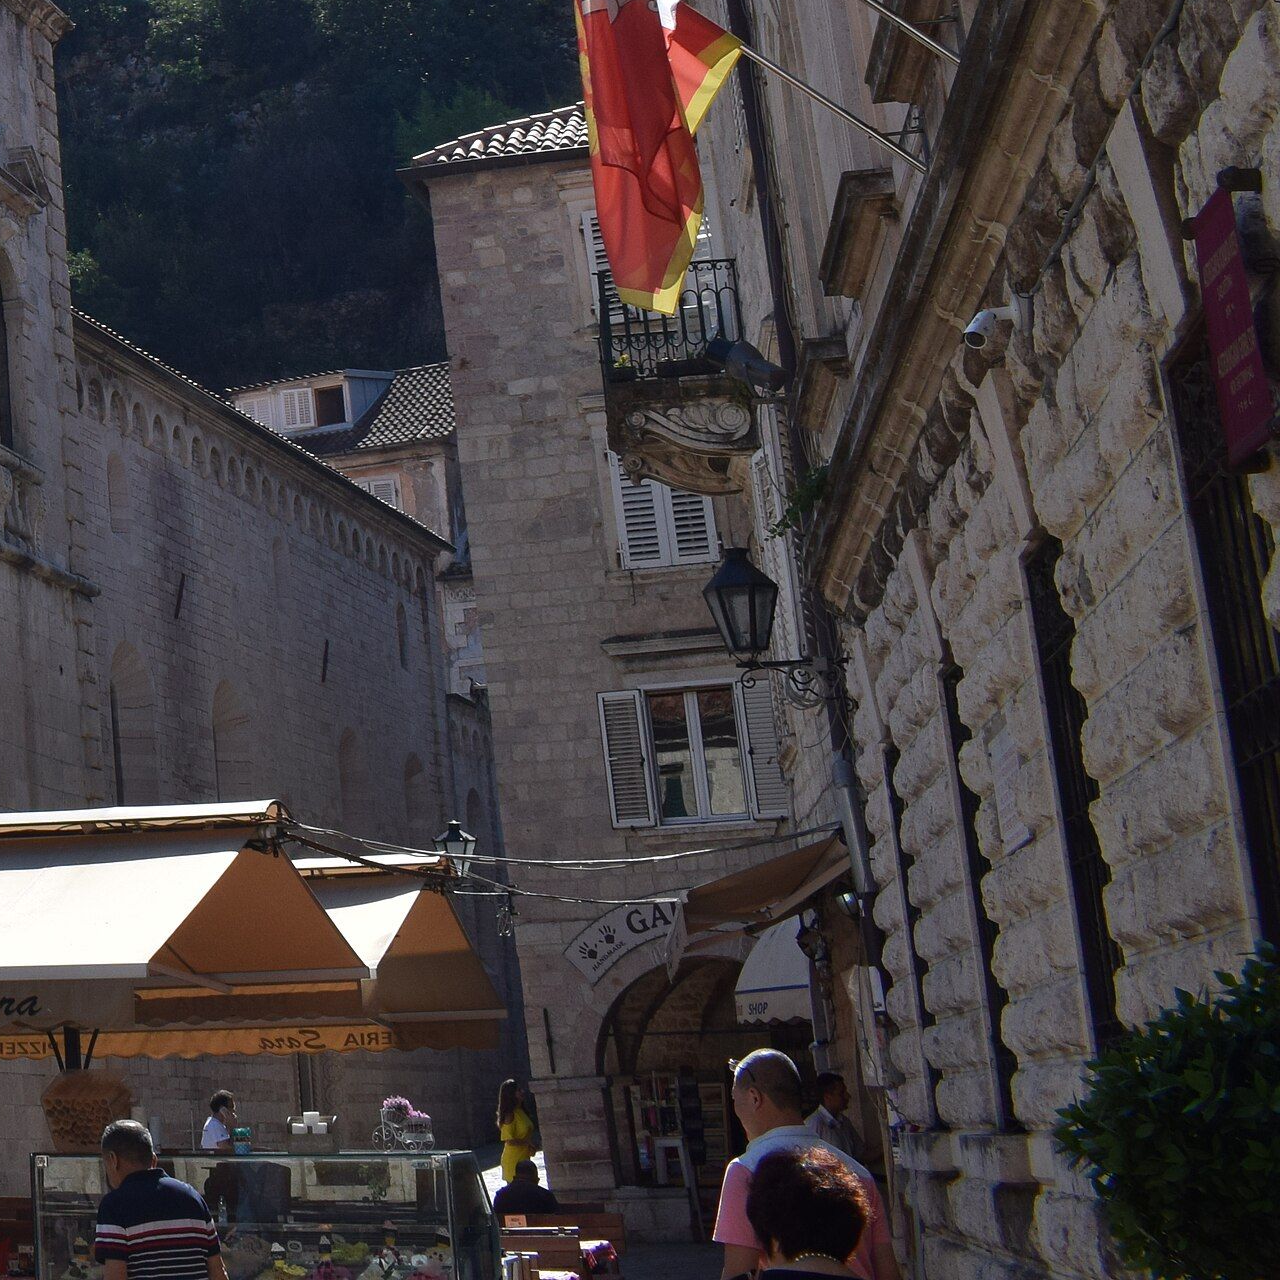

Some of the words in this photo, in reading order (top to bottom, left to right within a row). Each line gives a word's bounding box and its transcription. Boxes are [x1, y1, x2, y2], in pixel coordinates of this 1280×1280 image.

[626, 902, 677, 934] GA
[592, 941, 625, 972] HANDMADE
[748, 1002, 768, 1015] SHOP
